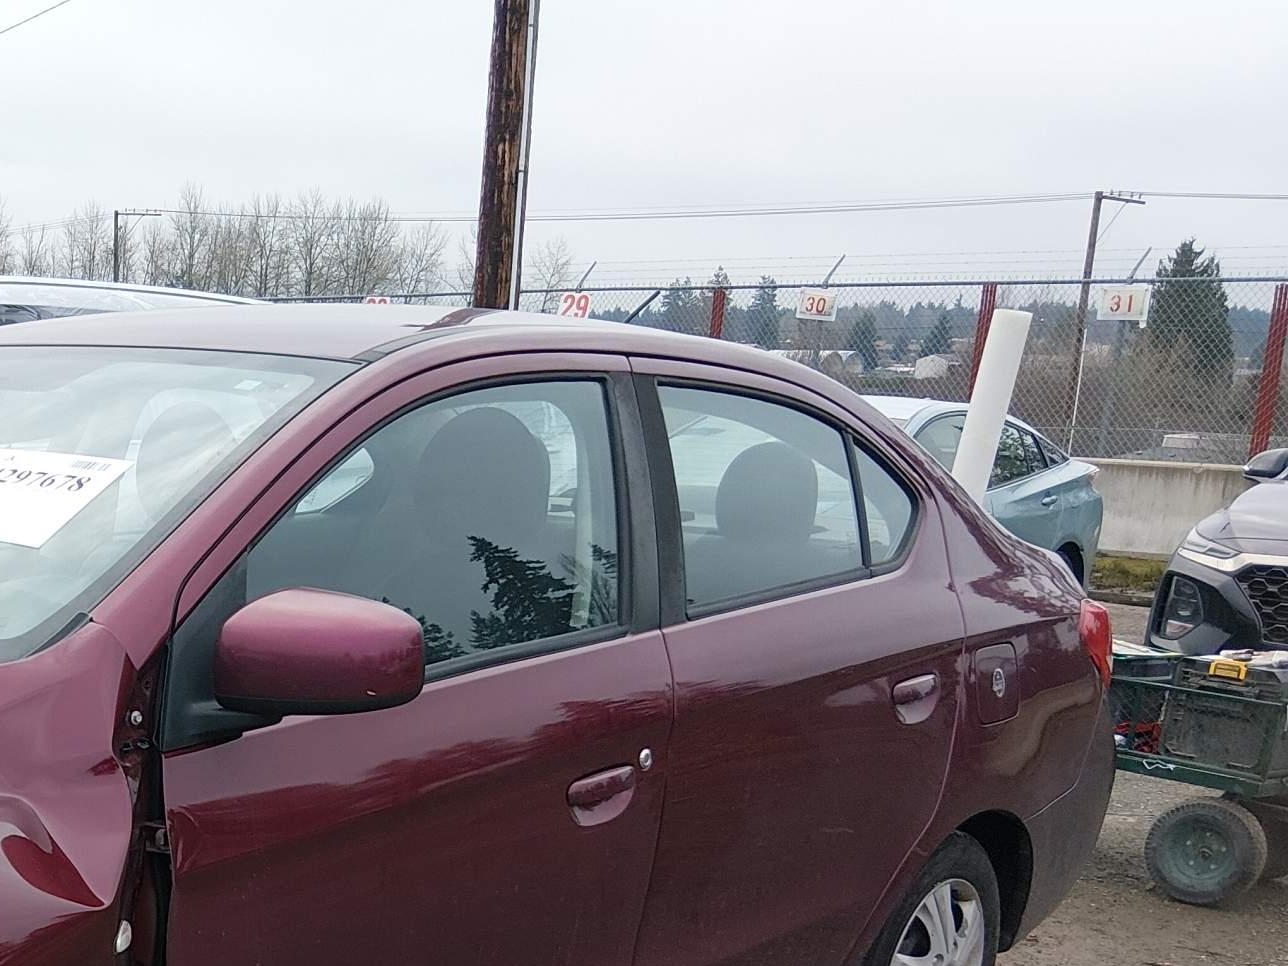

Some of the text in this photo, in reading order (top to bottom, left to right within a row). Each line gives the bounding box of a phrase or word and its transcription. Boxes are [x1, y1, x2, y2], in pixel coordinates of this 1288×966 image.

[561, 294, 589, 318] 29
[806, 296, 826, 313] 30
[1110, 294, 1133, 313] 31
